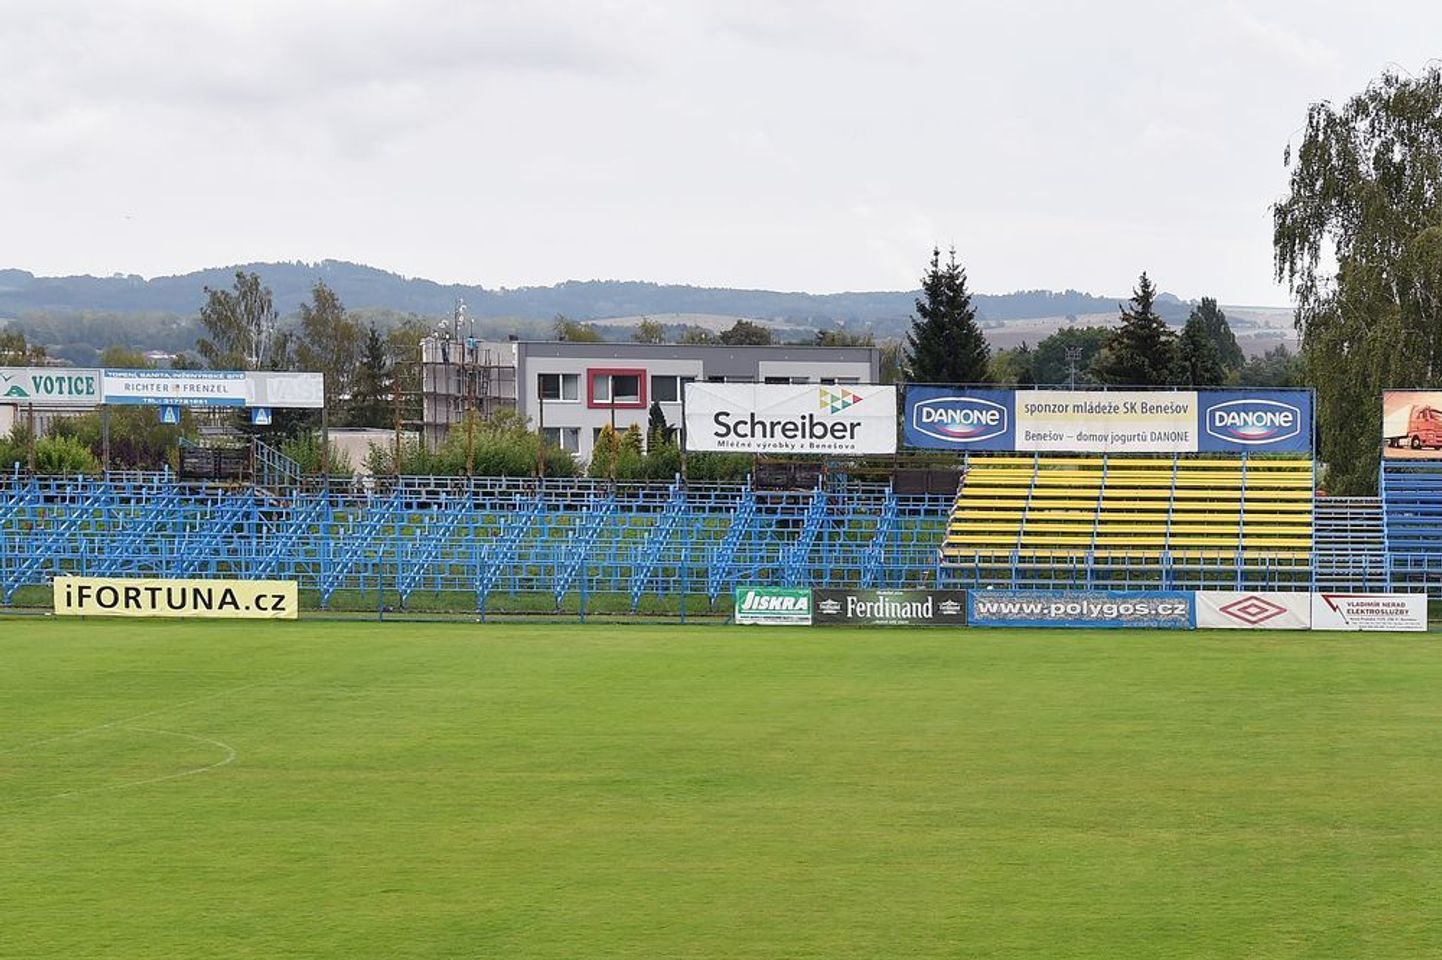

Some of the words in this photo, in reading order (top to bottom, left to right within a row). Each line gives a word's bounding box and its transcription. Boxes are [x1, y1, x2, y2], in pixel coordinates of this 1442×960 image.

[32, 375, 95, 396] VOTICE
[124, 382, 169, 392] RICHTER
[183, 384, 228, 393] FRENZEL
[1024, 404, 1068, 416] sponzor
[1073, 402, 1118, 414] mládeže
[1124, 402, 1136, 414] SK
[1141, 402, 1188, 414] Benešov
[714, 411, 861, 439] Schreiber
[756, 441, 795, 449] výrobky
[1024, 430, 1064, 441] Benešov
[1076, 431, 1109, 442] domov
[1110, 430, 1147, 444] jogurtů
[1150, 432, 1188, 442] DANONE
[66, 584, 286, 611] iFORTUNA.cz
[741, 592, 808, 610] JISKRA
[846, 596, 933, 618] Ferdinand
[978, 600, 1186, 617] www.polygos.cz
